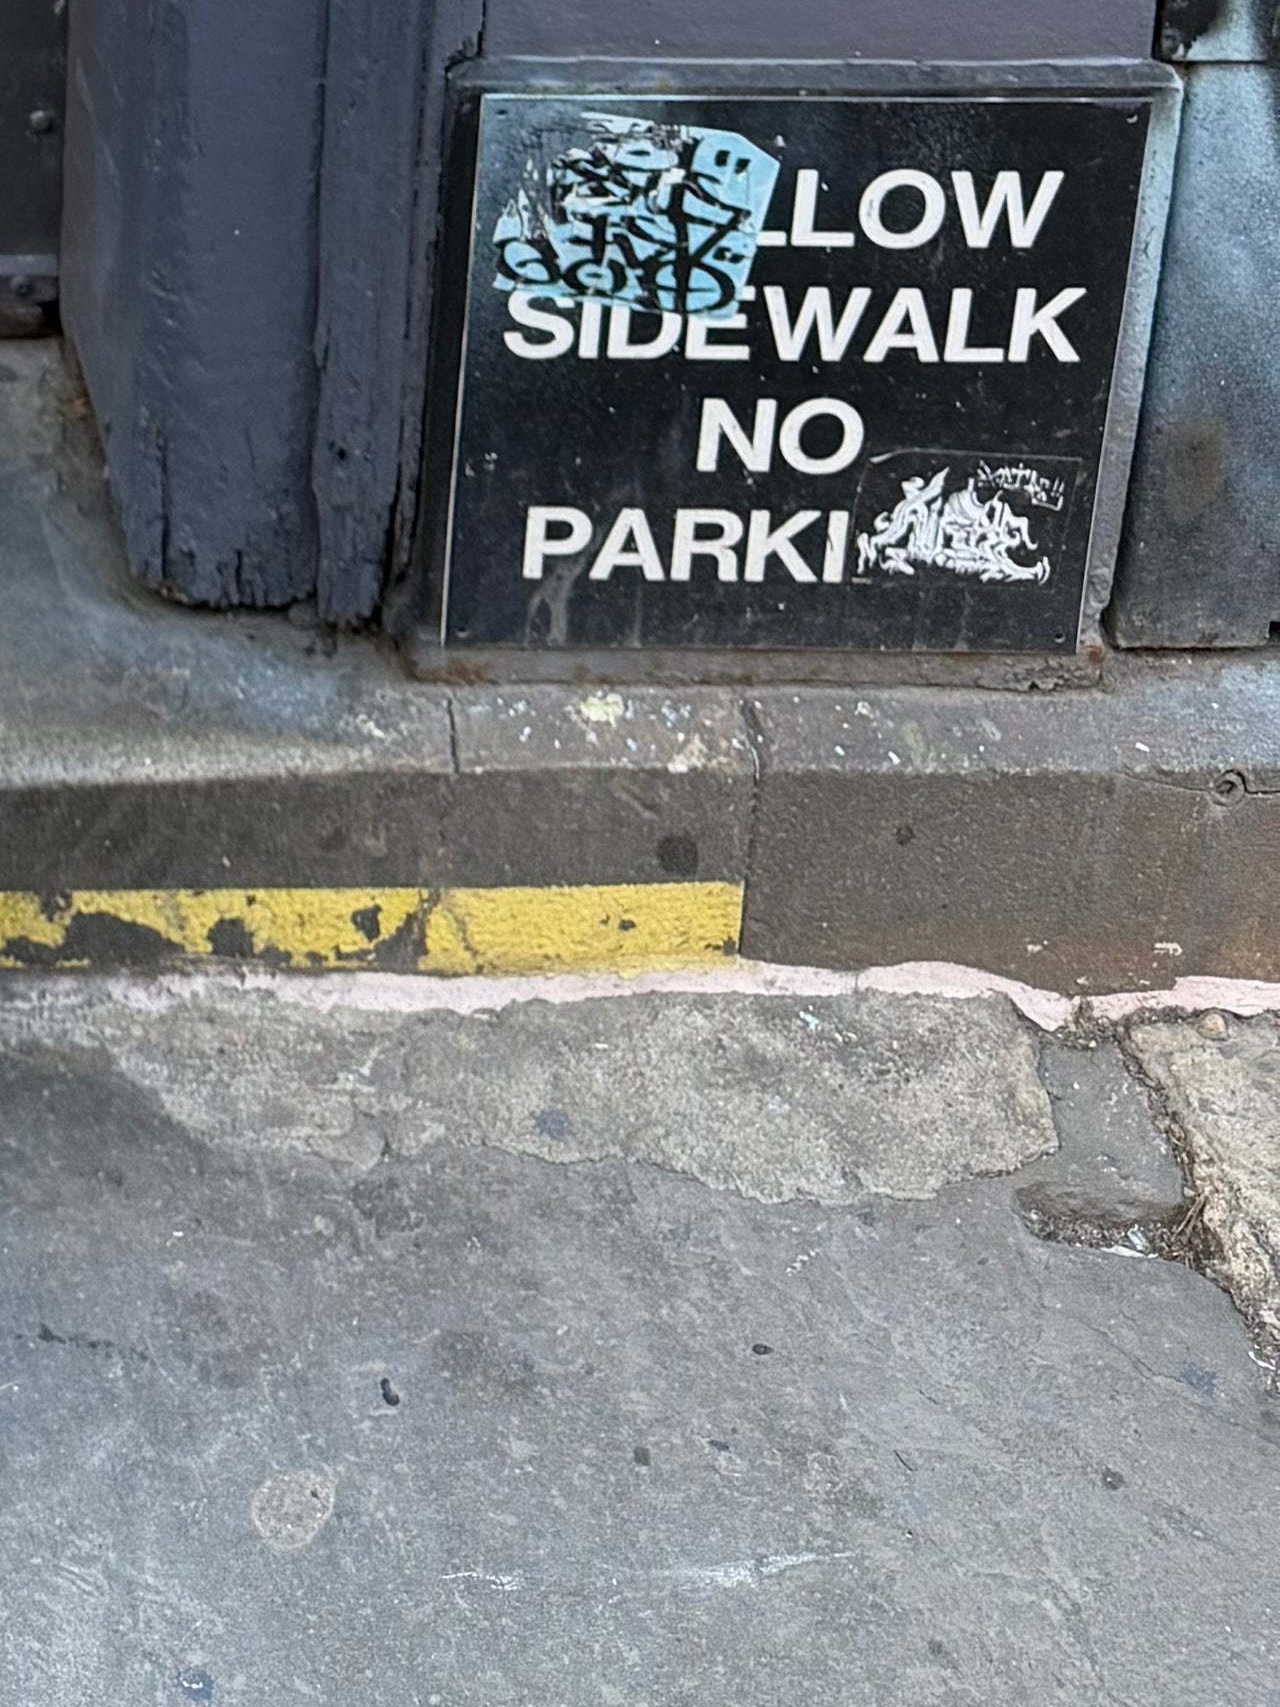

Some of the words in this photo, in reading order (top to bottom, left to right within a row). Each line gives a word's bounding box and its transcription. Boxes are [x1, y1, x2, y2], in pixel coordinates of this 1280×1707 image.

[756, 169, 1065, 249] LOW
[504, 287, 1086, 362] SIDEWALK
[697, 399, 865, 474] NO
[522, 508, 848, 583] PARKI
